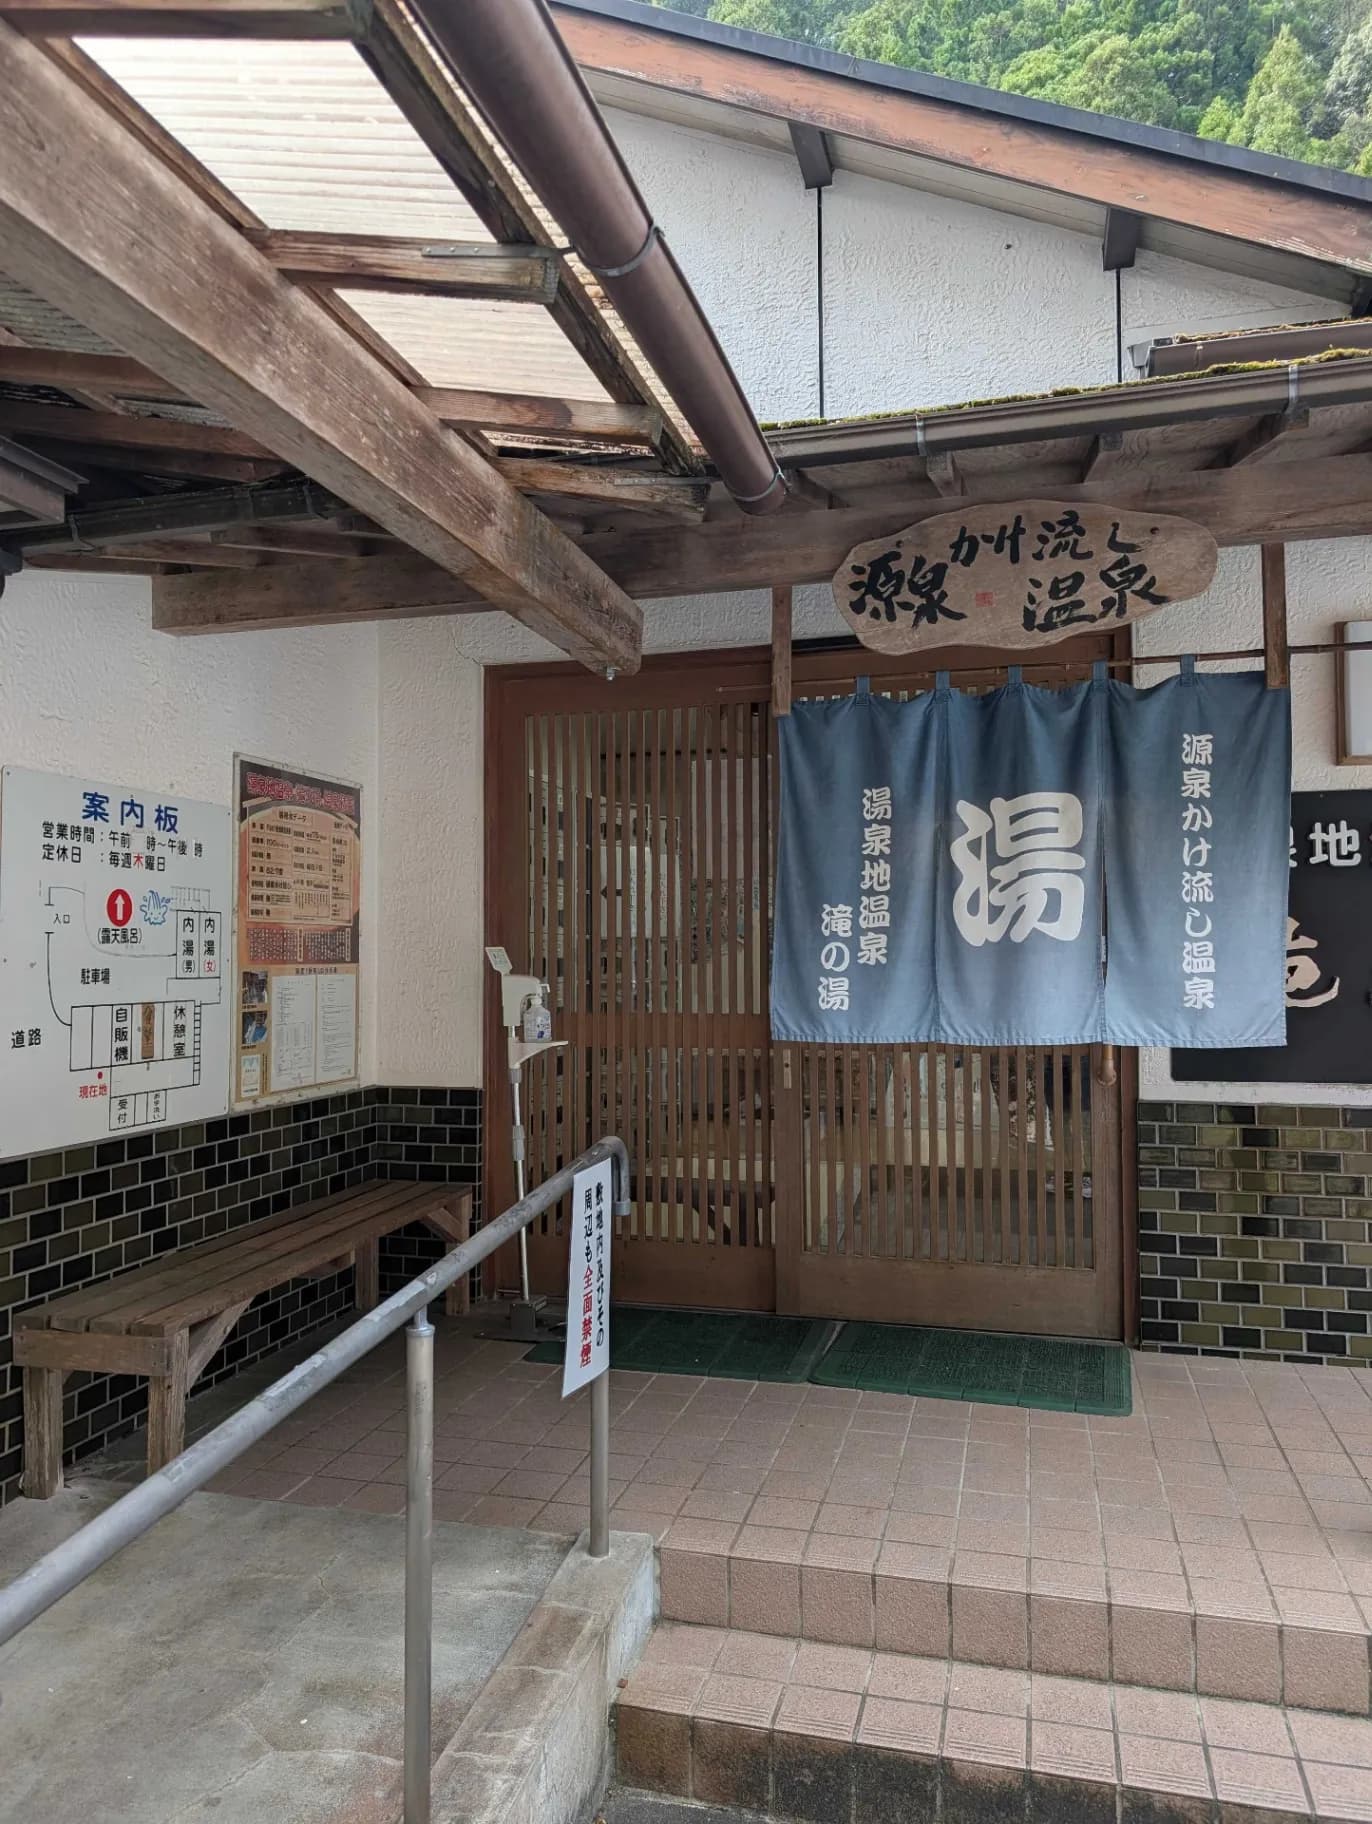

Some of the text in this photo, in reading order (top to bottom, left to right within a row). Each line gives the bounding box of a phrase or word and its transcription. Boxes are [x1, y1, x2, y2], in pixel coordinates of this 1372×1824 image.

[849, 551, 968, 629] 源泉
[1022, 554, 1172, 633] 温泉
[81, 791, 180, 835] 案内板
[42, 843, 82, 864] 定休日
[857, 786, 892, 967] 湯泉地温泉
[949, 791, 1087, 948] 湯
[1181, 733, 1216, 1011] 源泉かけ流し温泉
[53, 913, 71, 925] 入口
[80, 967, 111, 985] 駐車場
[818, 903, 854, 1012] 滝の湯
[11, 1027, 42, 1050] 道路
[114, 1007, 129, 1063] 自販機
[79, 1083, 108, 1100] 現在地
[117, 1097, 128, 1124] 受付
